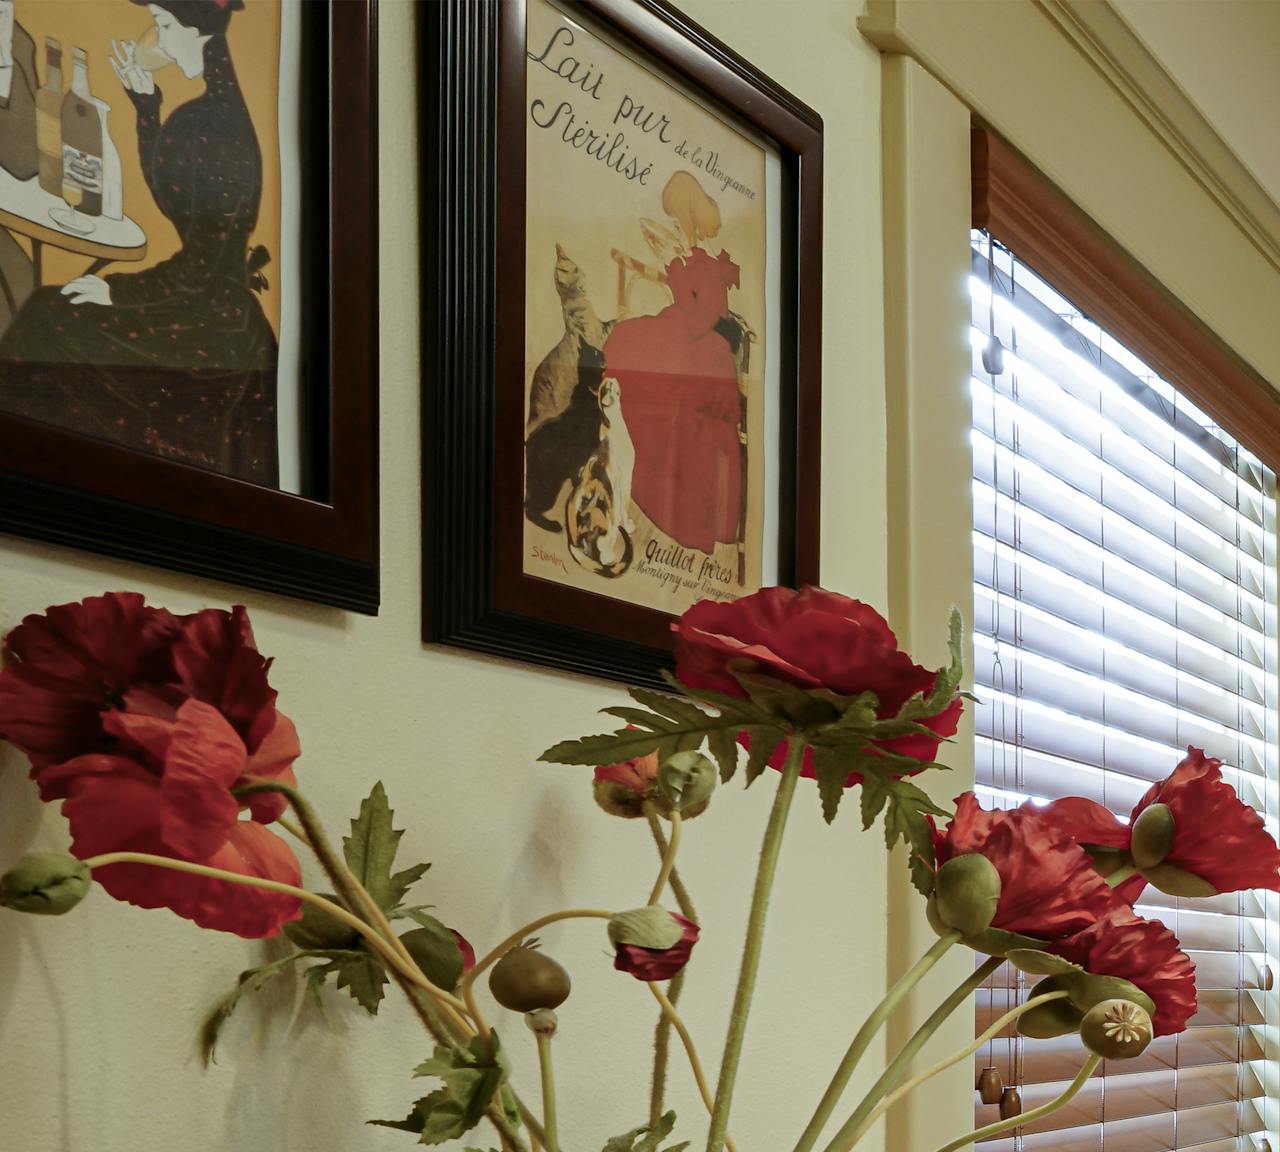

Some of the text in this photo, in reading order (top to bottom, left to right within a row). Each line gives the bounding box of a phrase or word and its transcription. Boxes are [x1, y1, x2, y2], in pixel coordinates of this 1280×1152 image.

[527, 27, 602, 100] Lait
[613, 95, 671, 143] pur
[674, 140, 688, 159] de
[691, 147, 703, 168] la
